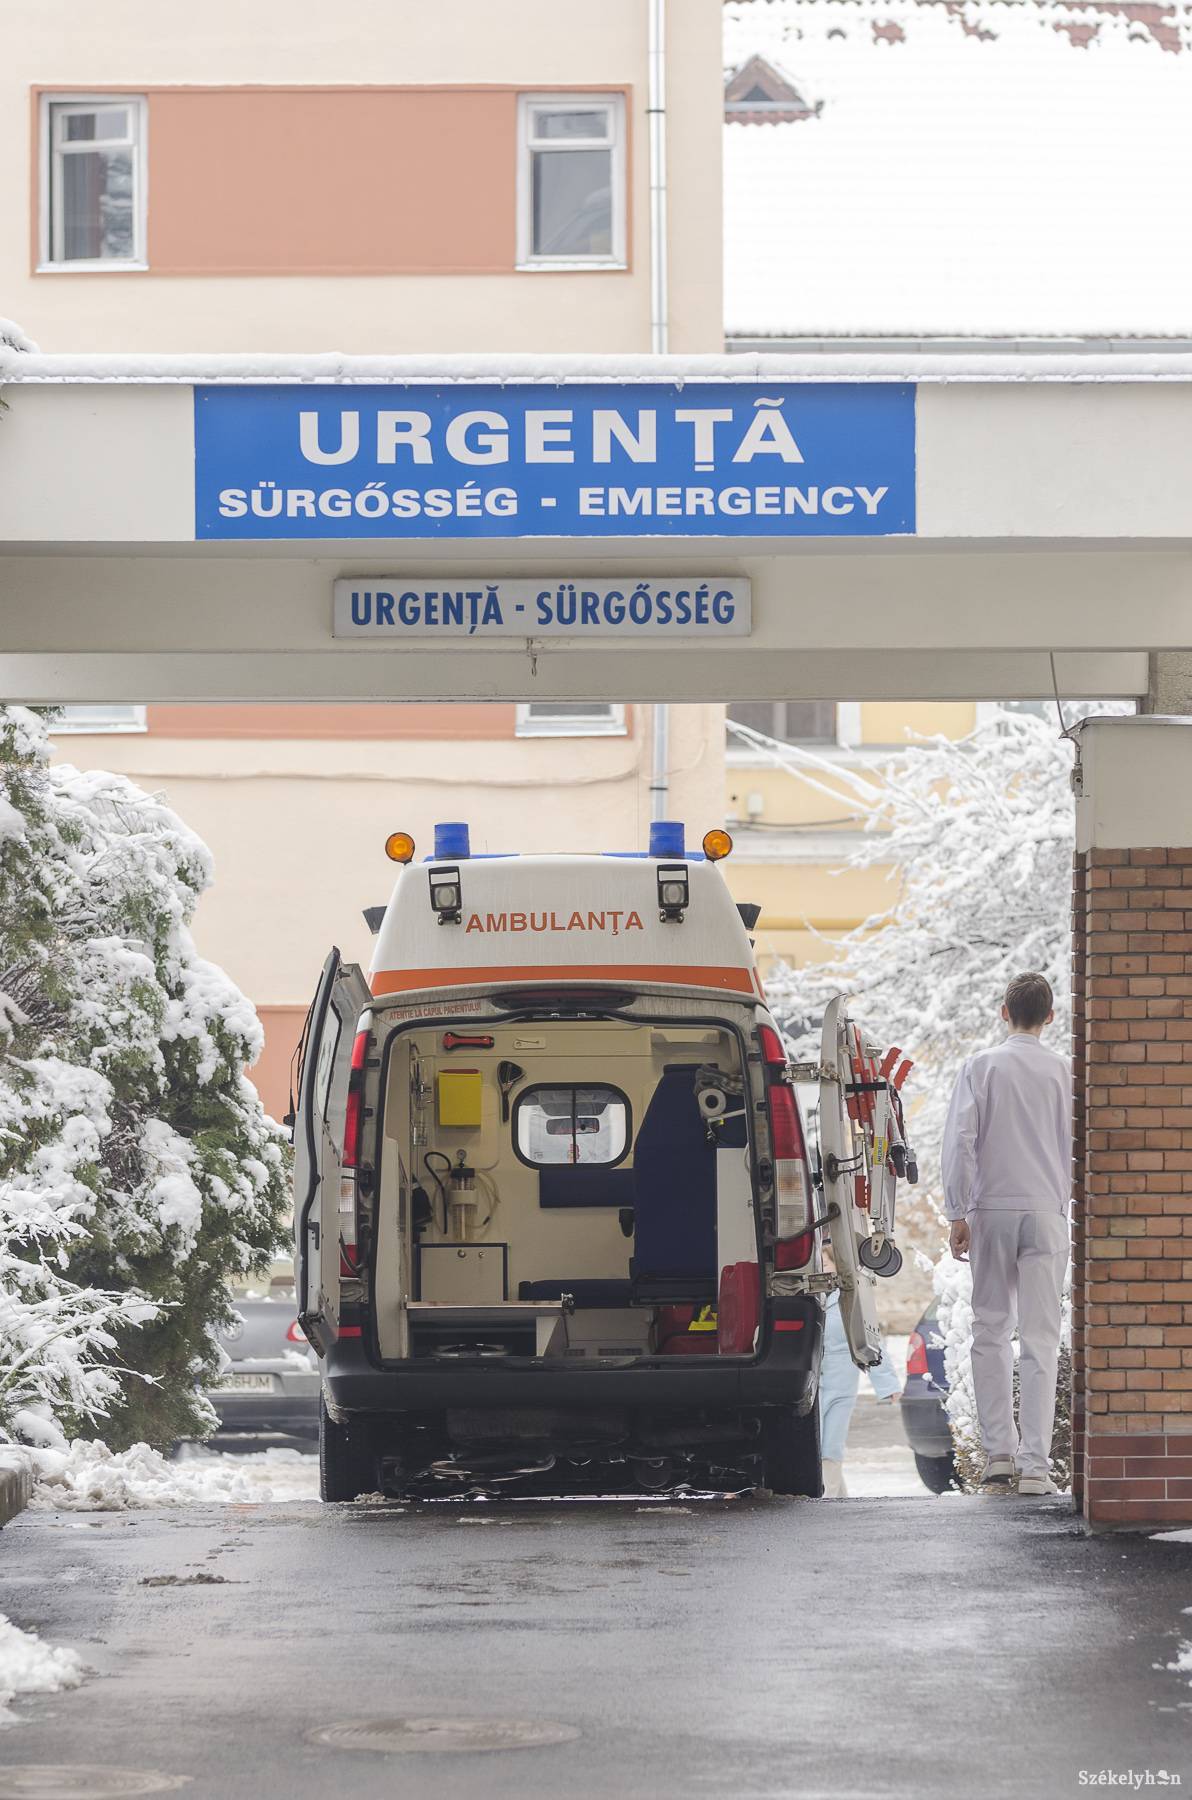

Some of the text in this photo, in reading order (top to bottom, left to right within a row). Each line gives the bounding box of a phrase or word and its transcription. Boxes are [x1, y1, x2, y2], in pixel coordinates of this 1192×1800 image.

[218, 480, 889, 518] SÜRGŐSSÉG - EMERGENCY
[515, 604, 525, 612] -
[536, 583, 735, 625] SÜRGŐSSÉG
